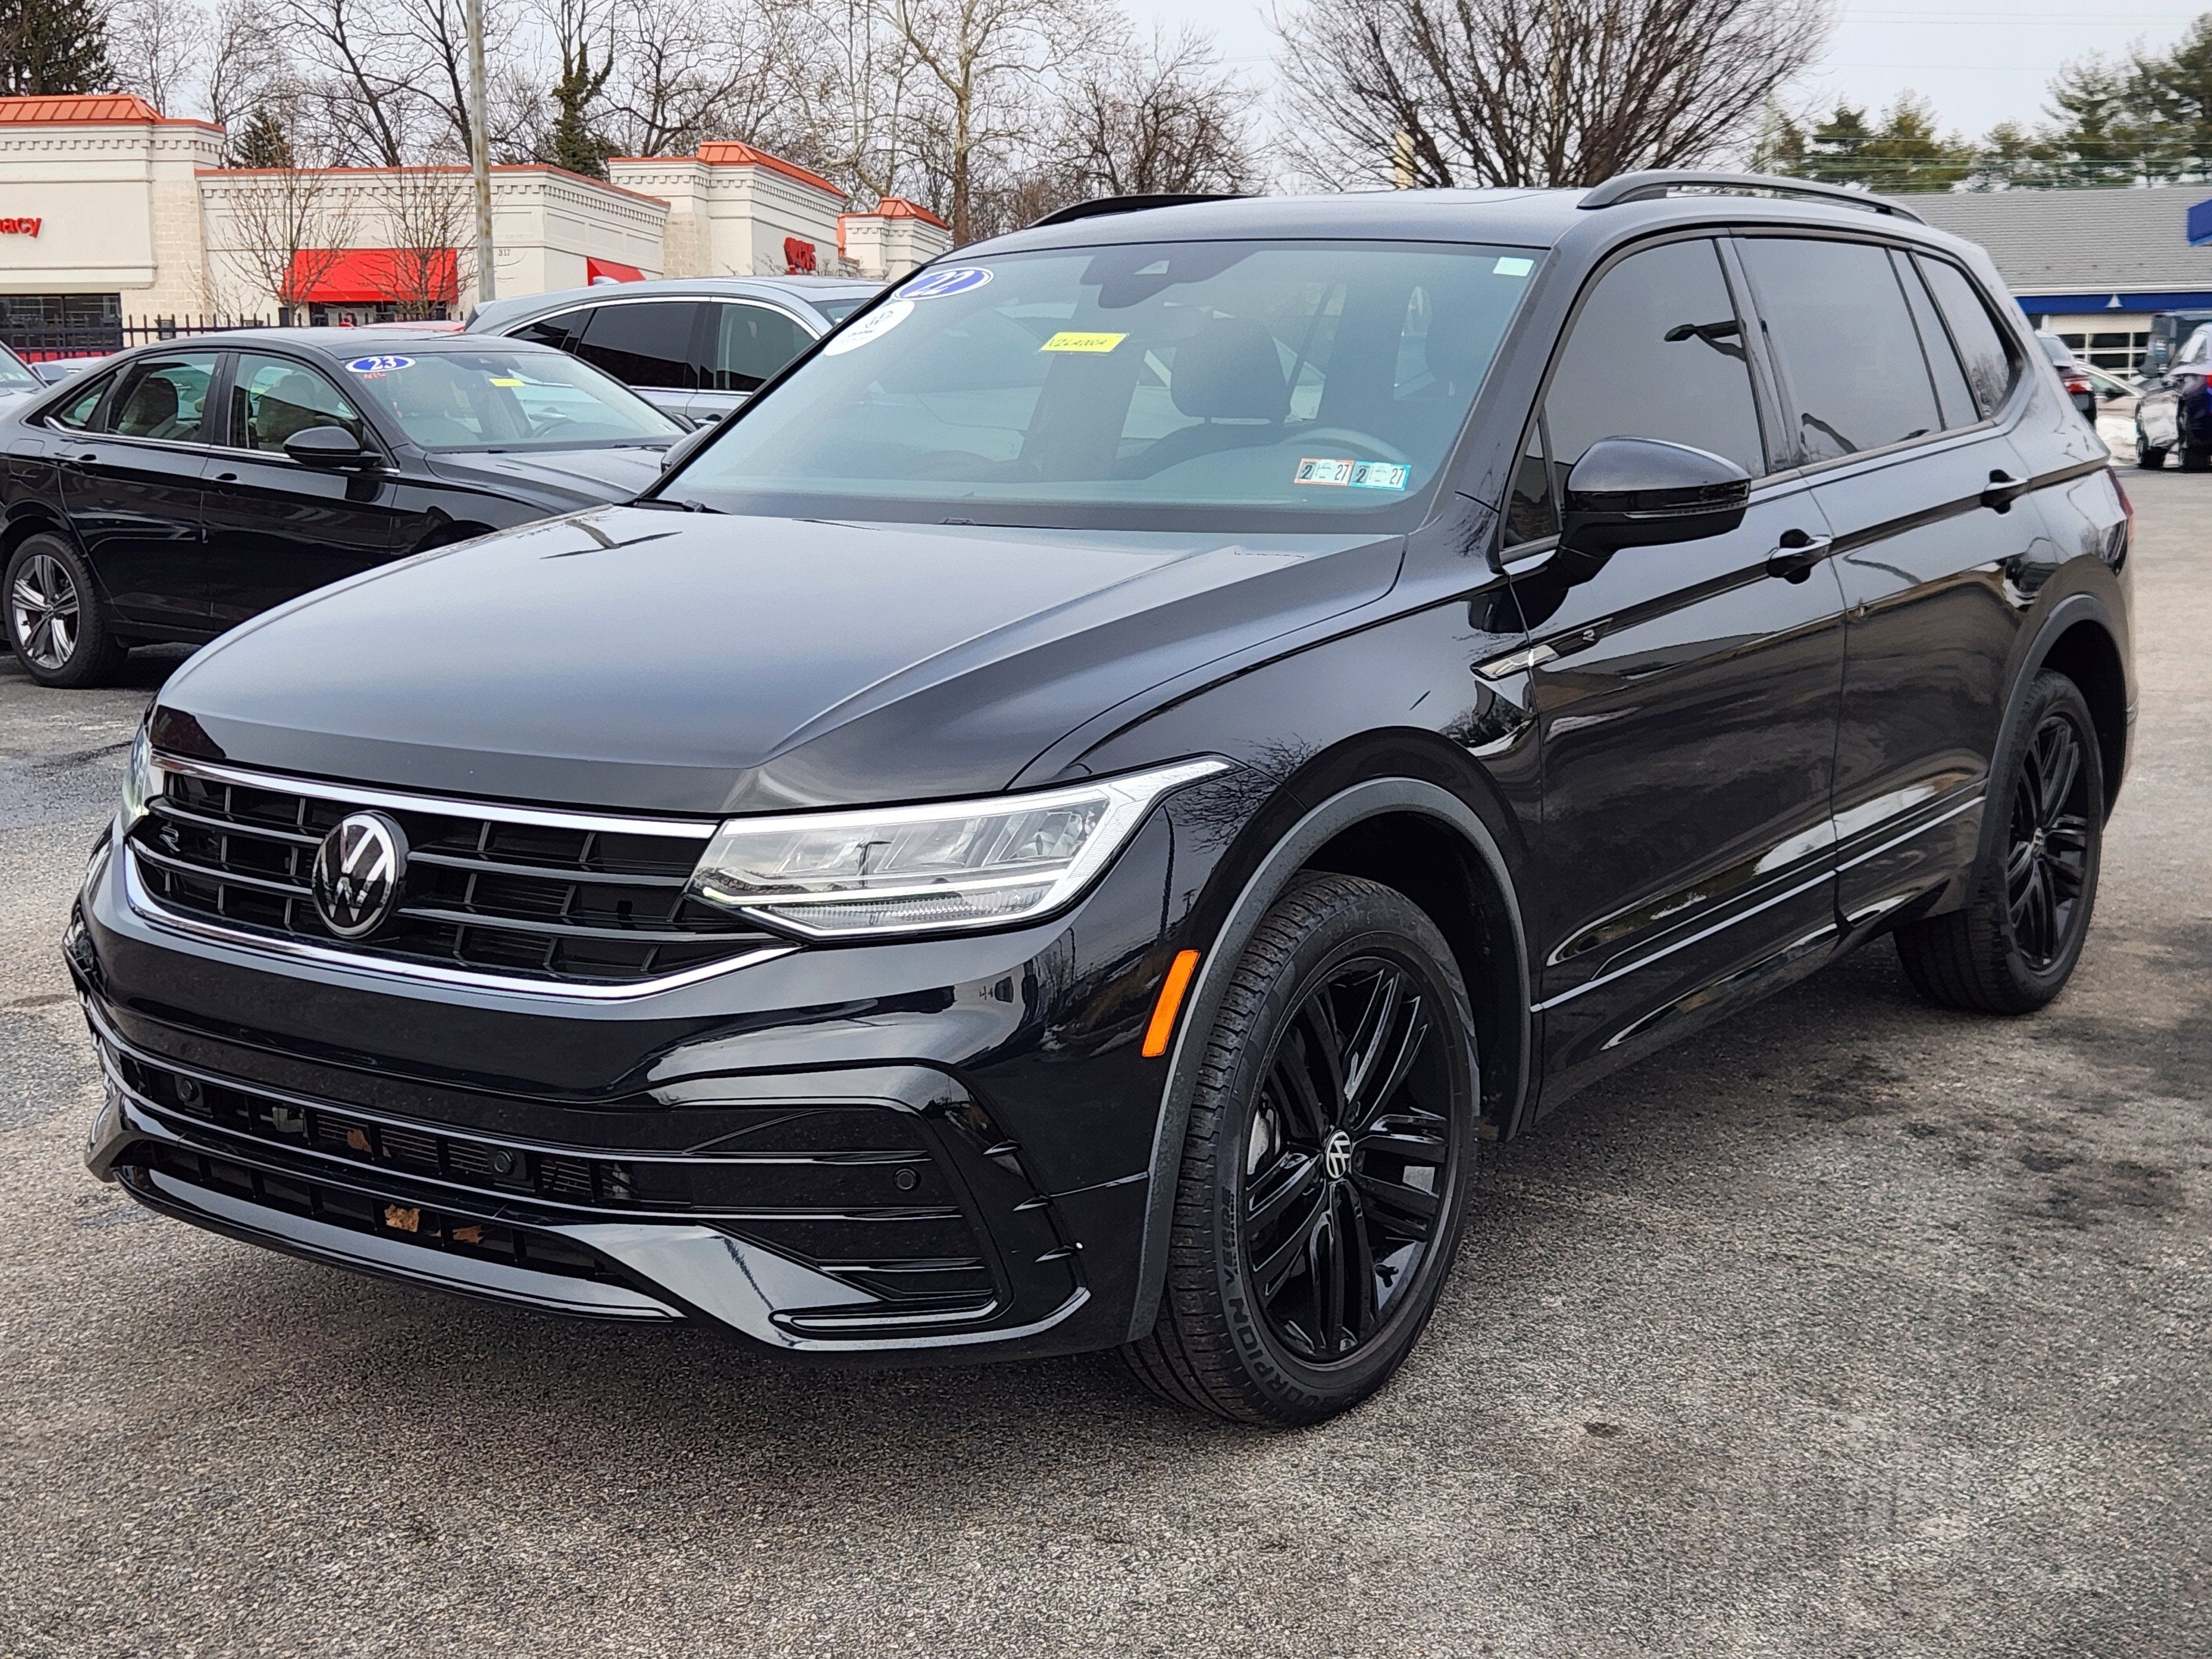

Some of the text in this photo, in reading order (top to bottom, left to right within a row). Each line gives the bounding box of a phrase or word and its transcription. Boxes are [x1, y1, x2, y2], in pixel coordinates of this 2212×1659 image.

[0, 218, 41, 238] acy
[903, 270, 974, 297] 22
[368, 356, 397, 371] 23
[1300, 464, 1349, 482] 2 27
[1354, 468, 1405, 486] 2 27
[1222, 1186, 1235, 1287] VERDE
